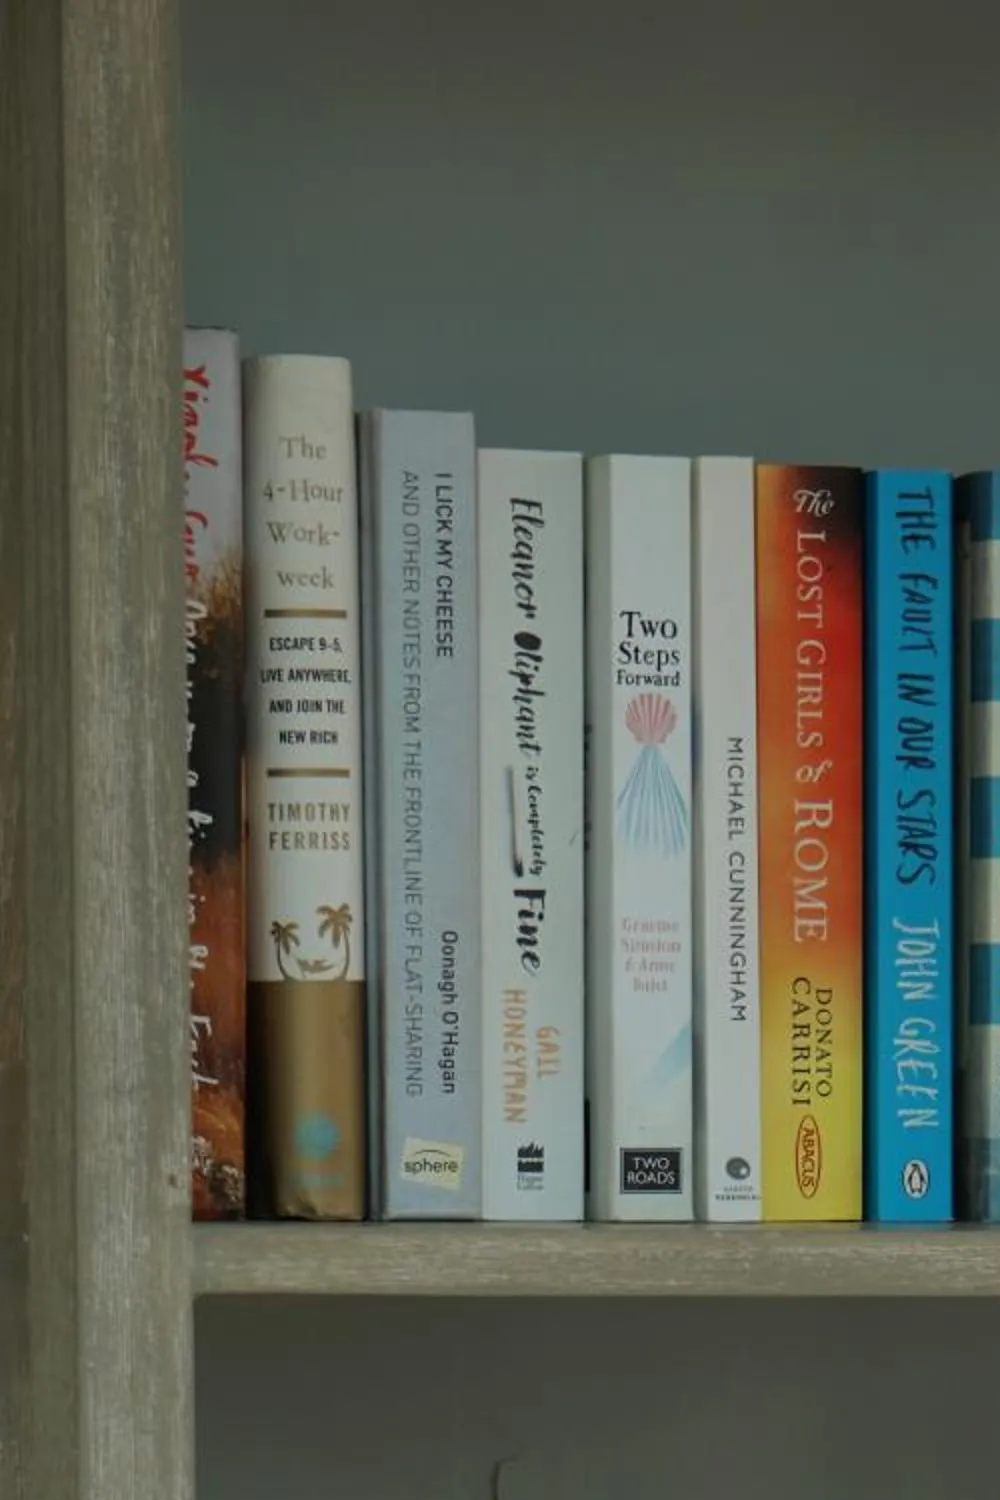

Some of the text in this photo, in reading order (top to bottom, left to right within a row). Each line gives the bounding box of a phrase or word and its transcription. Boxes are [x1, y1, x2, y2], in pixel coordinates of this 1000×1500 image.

[278, 435, 328, 461] The
[262, 479, 344, 504] 4-Hour
[277, 565, 335, 591] week
[434, 484, 454, 658] LICK MY CHEESE
[508, 497, 546, 757] Eleanor Oliphant
[619, 610, 678, 641] Two
[269, 636, 316, 652] ESCAPE
[618, 640, 680, 673] Steps
[260, 668, 352, 685] LIVE ANYWHERE,
[617, 668, 680, 688] Forward
[896, 487, 938, 885] THE FAULT IN OUR STARS
[269, 698, 346, 714] AND JOIN THE
[793, 488, 835, 942] The LOST GIRLS of ROME
[278, 729, 339, 746] NEW RICH
[402, 470, 424, 1097] AND OTHER NOTES FROM THE FRONTLINE OF FLAT-SHARING
[267, 801, 351, 823] TIMOTHY
[268, 830, 351, 852] FERRISS
[727, 737, 747, 1021] MICHAEL CUNNINGHAM
[513, 888, 547, 978] Fine
[438, 931, 459, 1095] Oonagh O'Hagan
[893, 916, 940, 1128] JOHN GREEN
[503, 989, 527, 1124] HONEYMAN
[536, 1026, 561, 1080] GAIL
[791, 976, 811, 1106] CARRISI
[815, 988, 833, 1098] DONATO
[404, 1156, 459, 1176] sphere
[633, 1156, 670, 1171] TWO
[802, 1128, 815, 1187] ABACUS
[627, 1171, 676, 1186] ROADS
